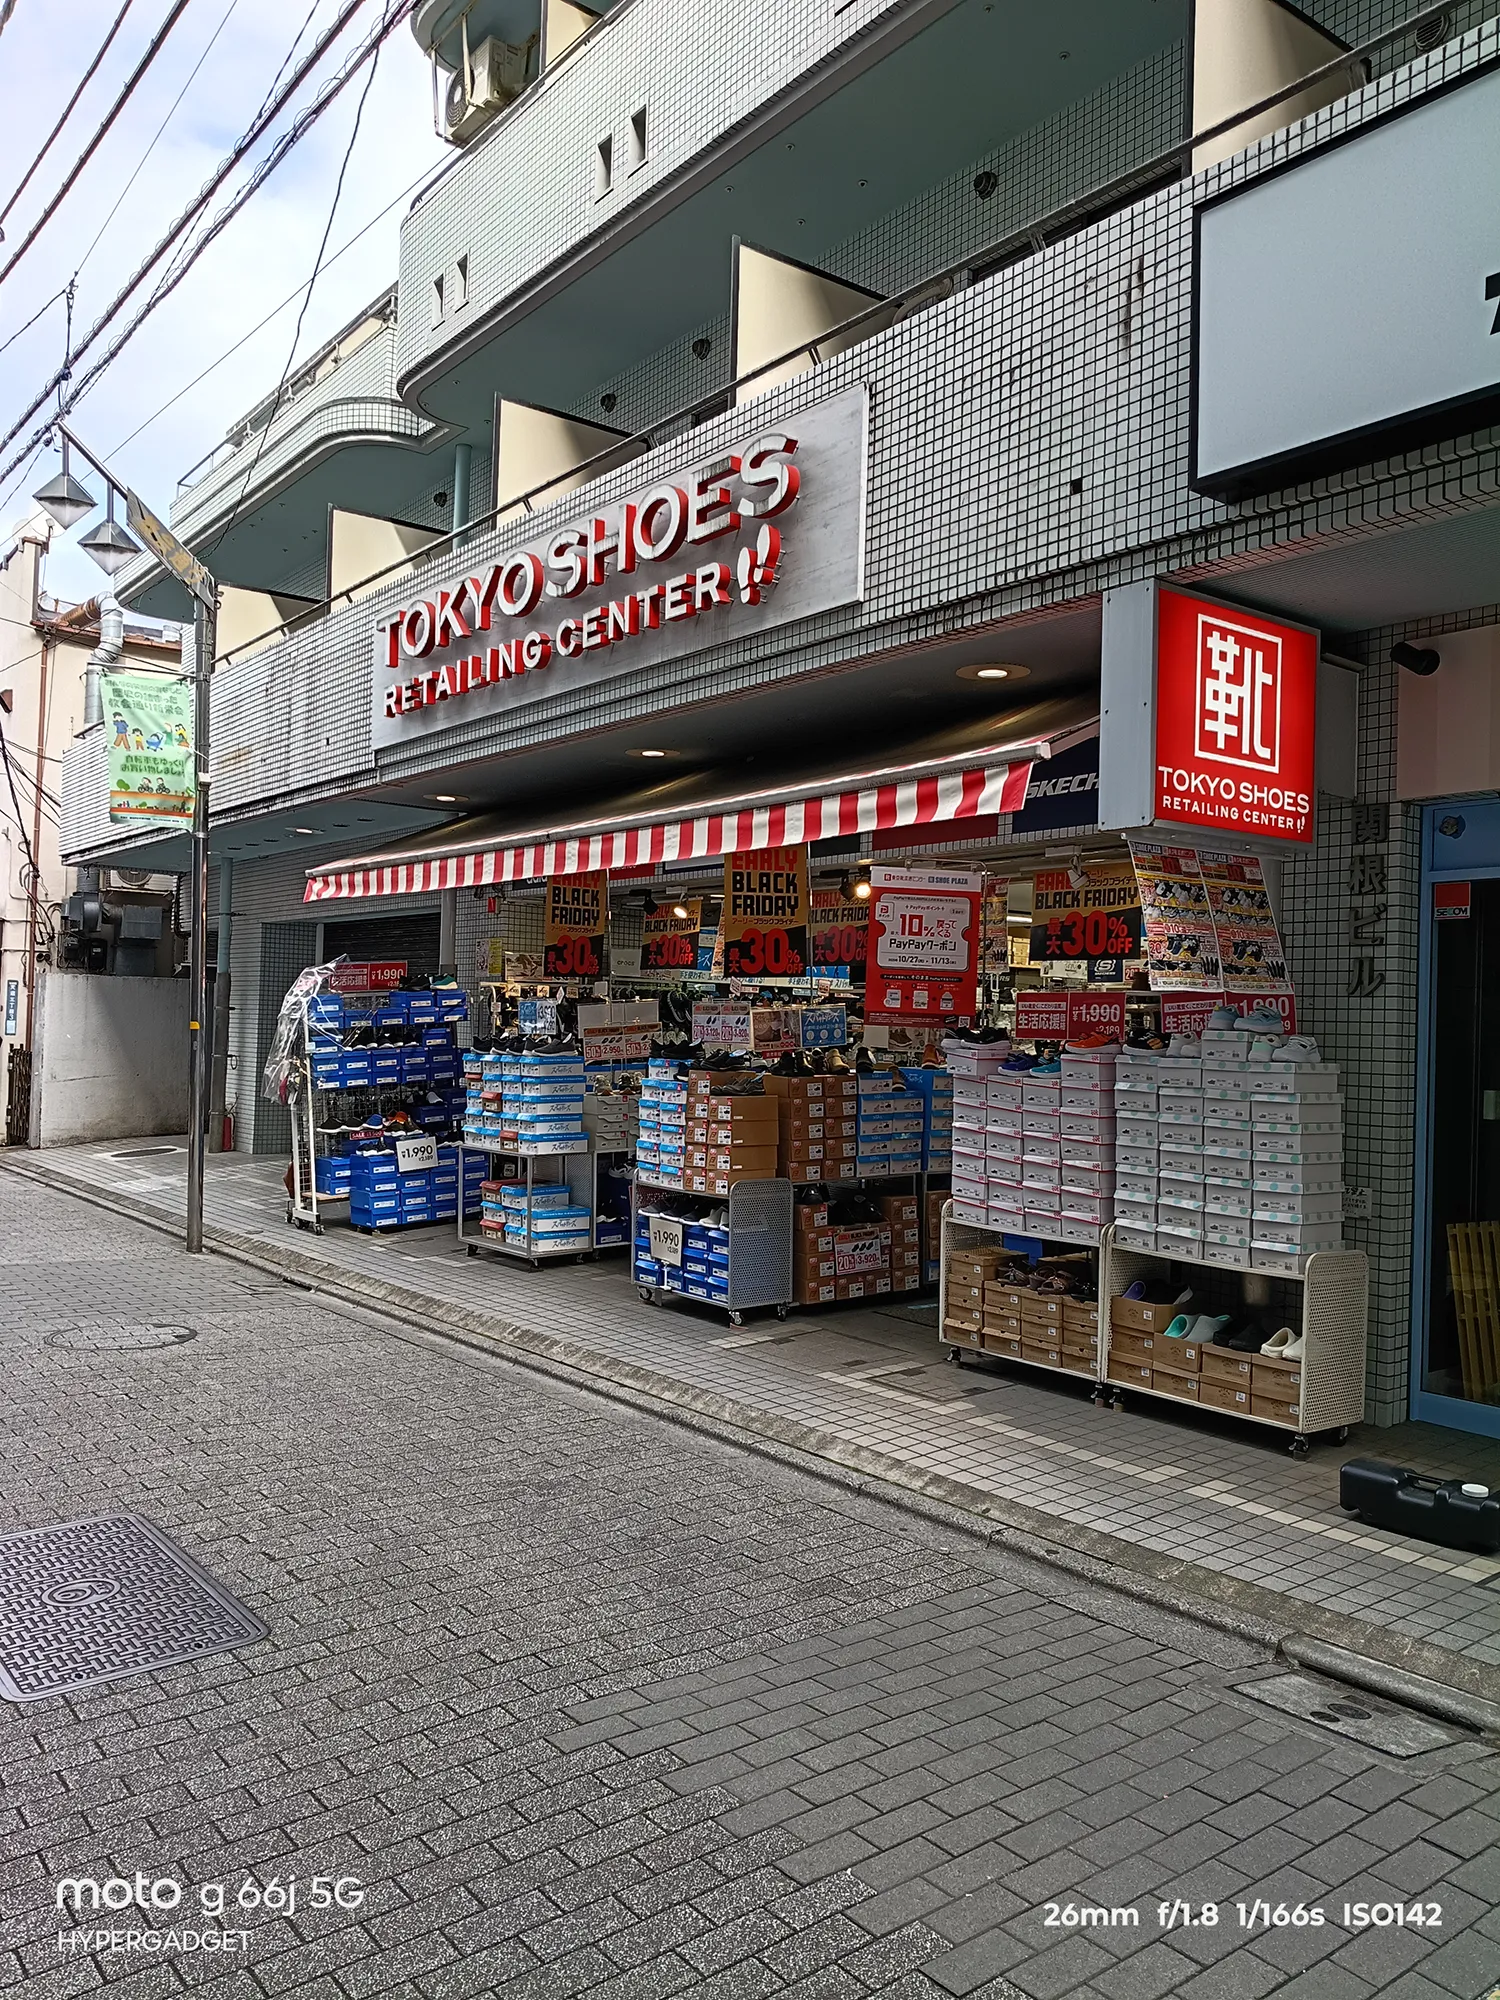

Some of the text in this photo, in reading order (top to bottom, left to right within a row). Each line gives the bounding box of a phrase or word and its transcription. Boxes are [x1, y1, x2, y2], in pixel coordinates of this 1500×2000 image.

[376, 432, 801, 668] TOKYO SHOES
[384, 631, 552, 718] RETAILING
[1204, 630, 1273, 760] 靴
[1158, 765, 1310, 814] TOKYO SHOES
[1162, 794, 1240, 821] RETAILING
[732, 849, 798, 872] EARLY
[732, 871, 798, 894] BLACK
[951, 877, 969, 885] PLAZA
[552, 886, 600, 908] BLACK
[732, 894, 799, 917] FRIDAY
[1035, 886, 1139, 910] BLACK FRIDAY
[1346, 803, 1389, 997] 関根ビル
[551, 905, 600, 927] FRIDAY
[1436, 907, 1468, 918] SECOM
[645, 917, 699, 933] BLACK FRIDAY
[937, 919, 958, 930] 戻って
[937, 929, 952, 938] くる
[889, 937, 957, 952] PayPayクーポン
[1107, 937, 1134, 955] OFF
[678, 952, 694, 965] OFF
[786, 963, 804, 975] OFF
